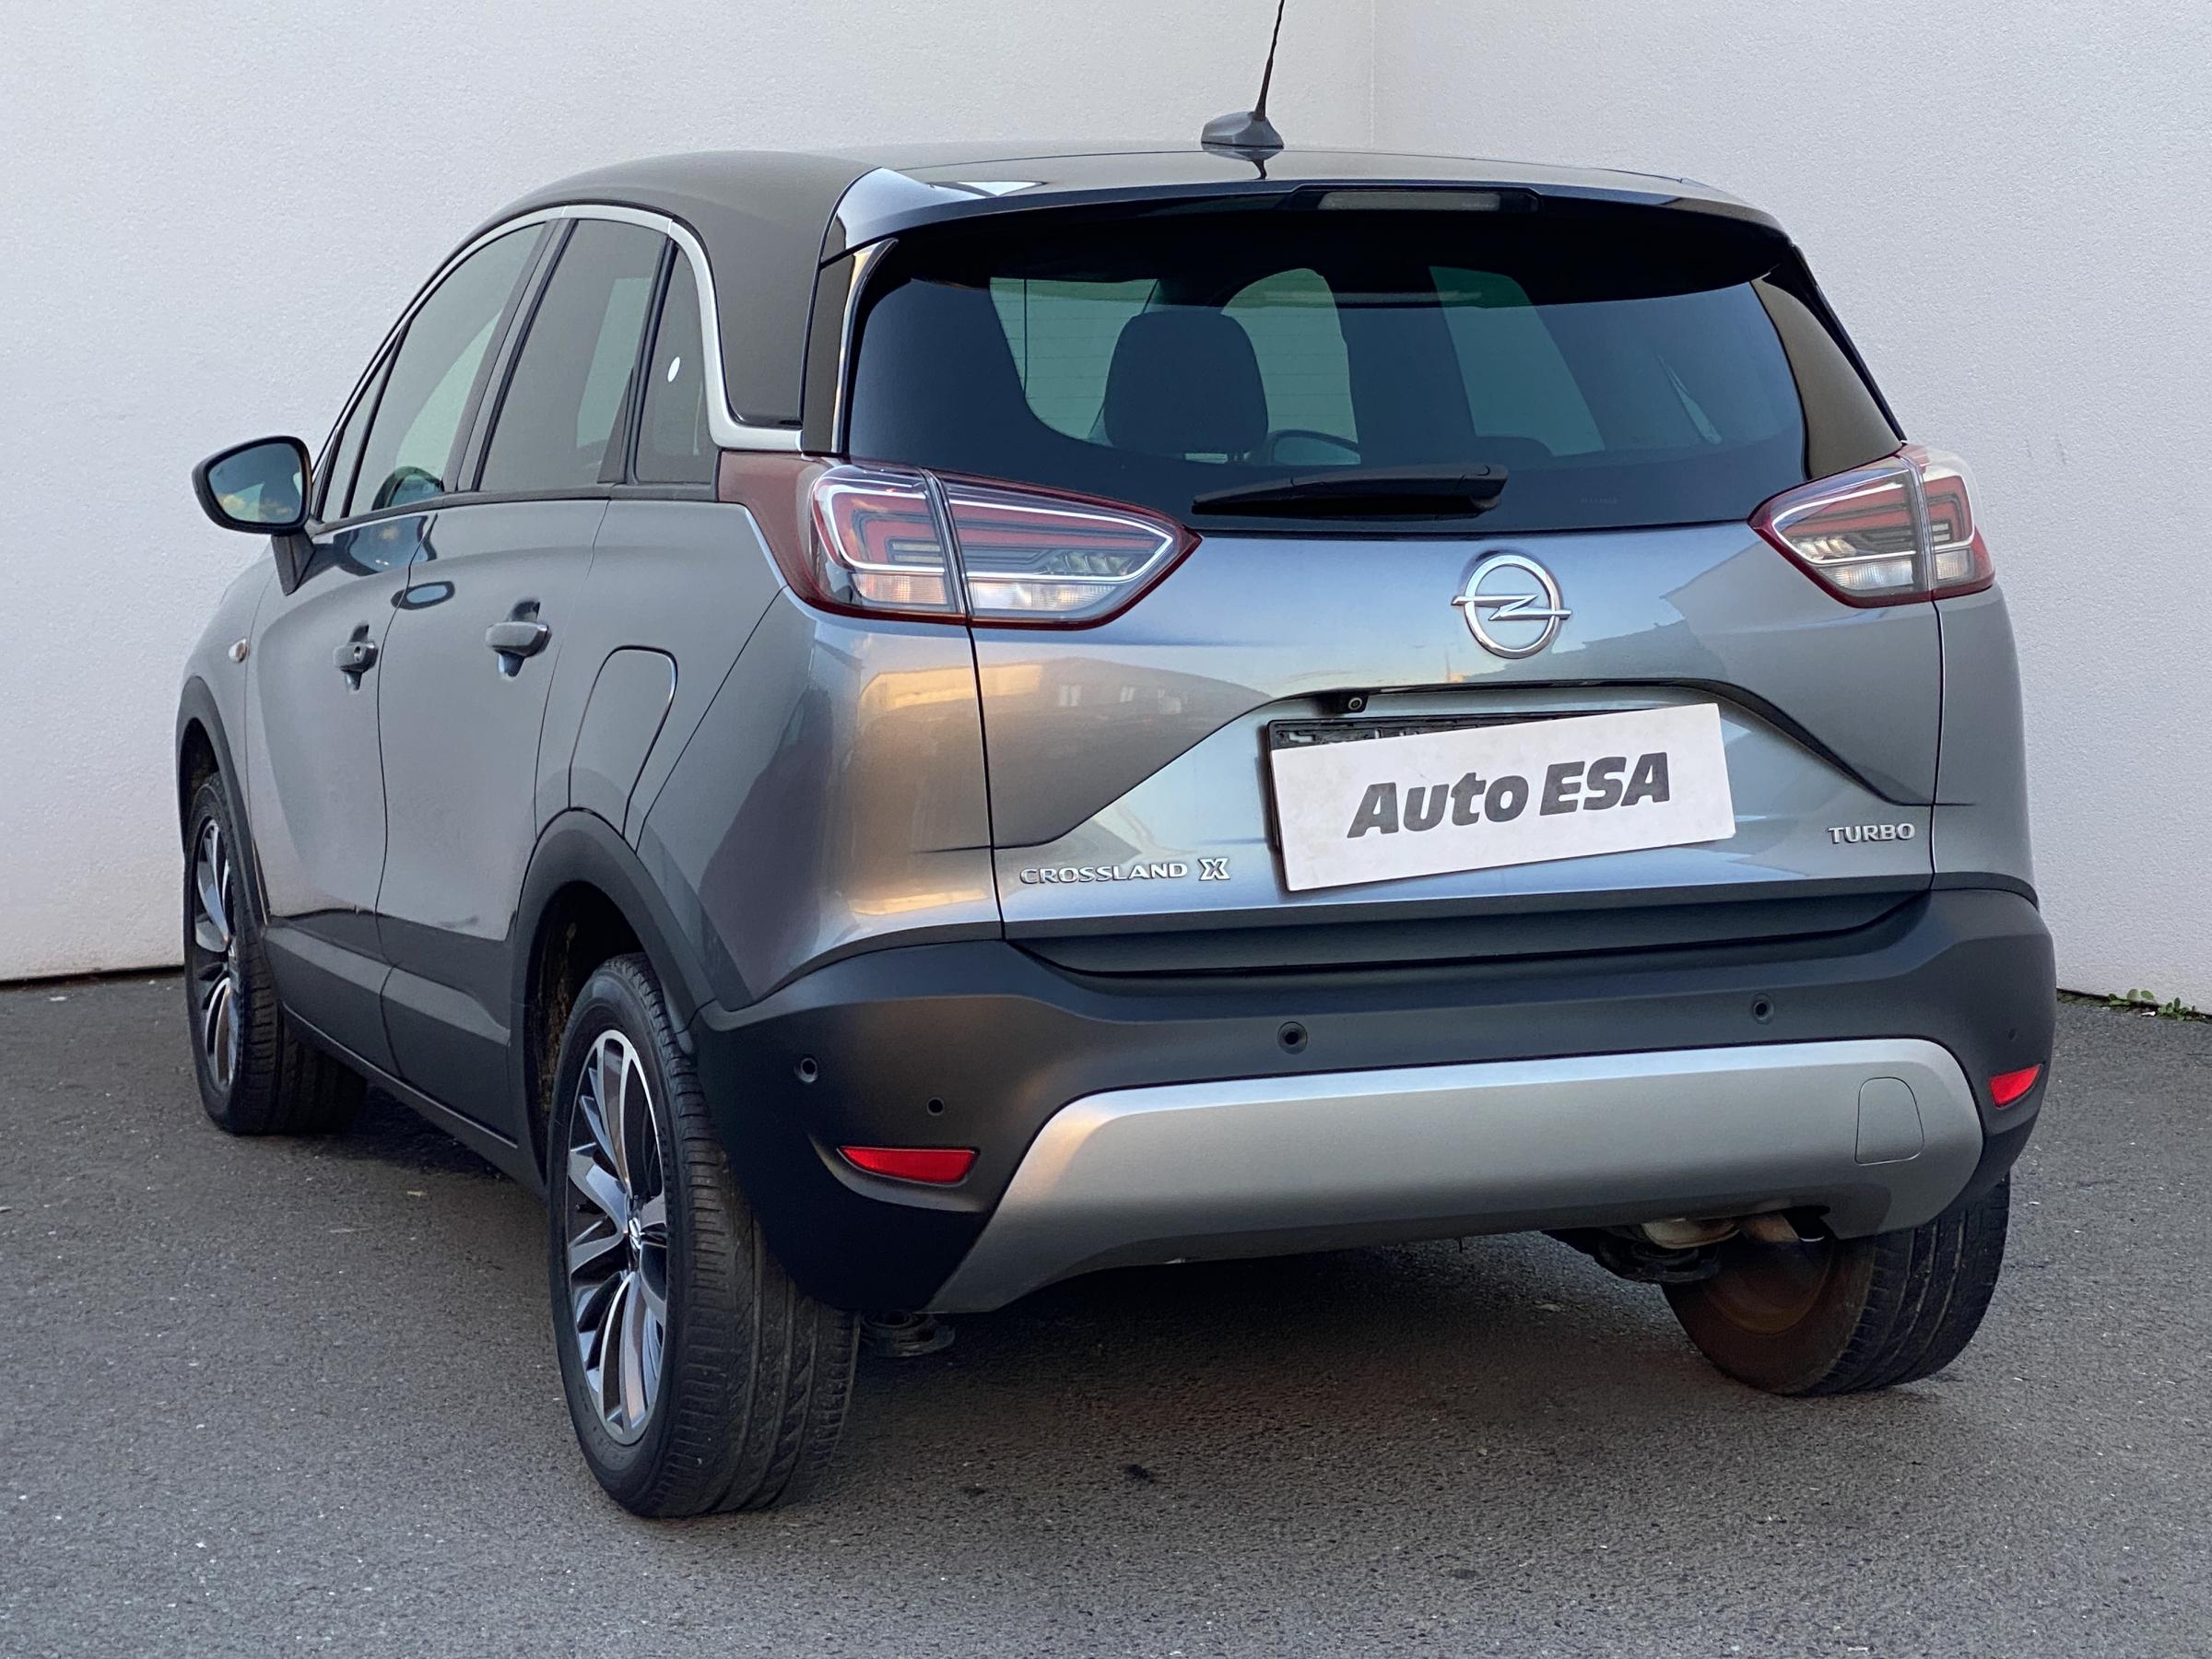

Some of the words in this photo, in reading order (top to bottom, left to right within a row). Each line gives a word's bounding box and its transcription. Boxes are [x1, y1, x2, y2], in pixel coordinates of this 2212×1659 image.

[1347, 772, 1530, 839] Auto
[1539, 751, 1670, 817] ESA
[1829, 822, 1915, 844] TURBO
[1019, 863, 1188, 884] CROSSLAND
[1198, 857, 1230, 881] X
